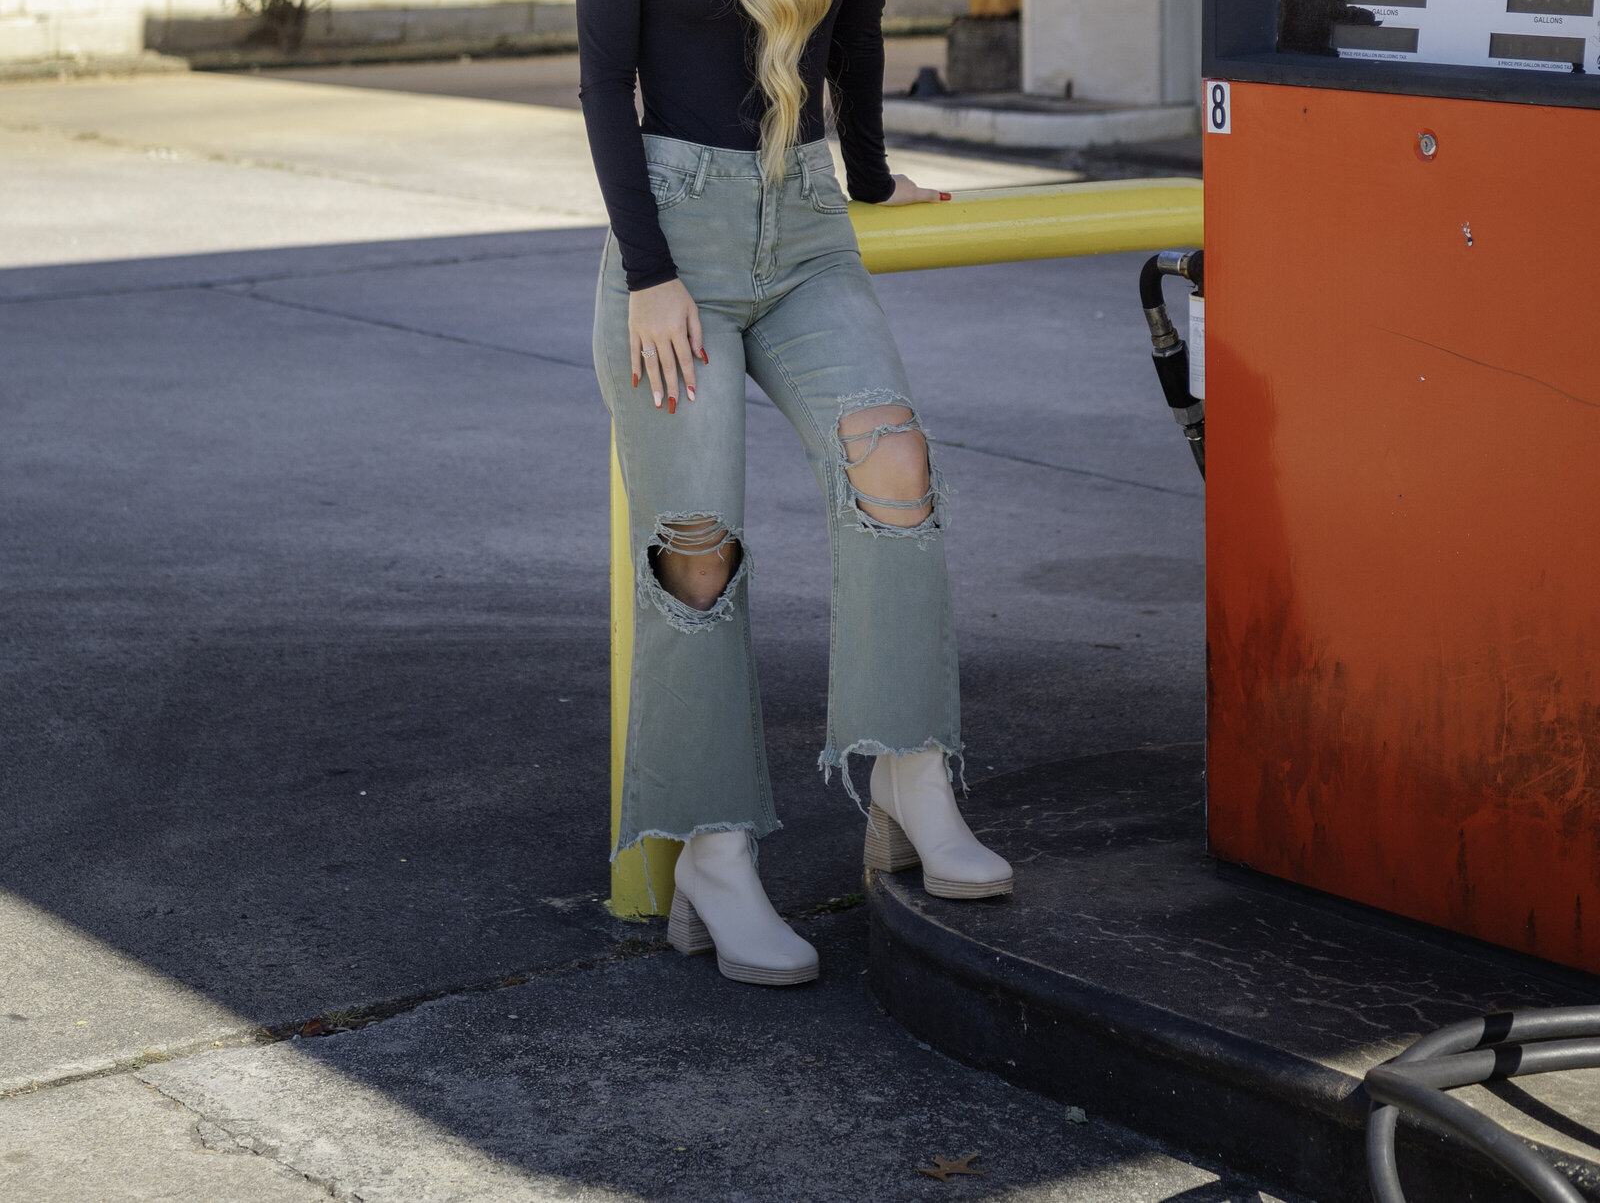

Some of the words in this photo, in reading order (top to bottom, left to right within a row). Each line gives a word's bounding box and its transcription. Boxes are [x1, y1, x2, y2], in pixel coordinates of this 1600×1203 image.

[1372, 8, 1399, 16] GALLONS
[1533, 16, 1563, 24] GALLONS
[1212, 84, 1226, 129] 8
